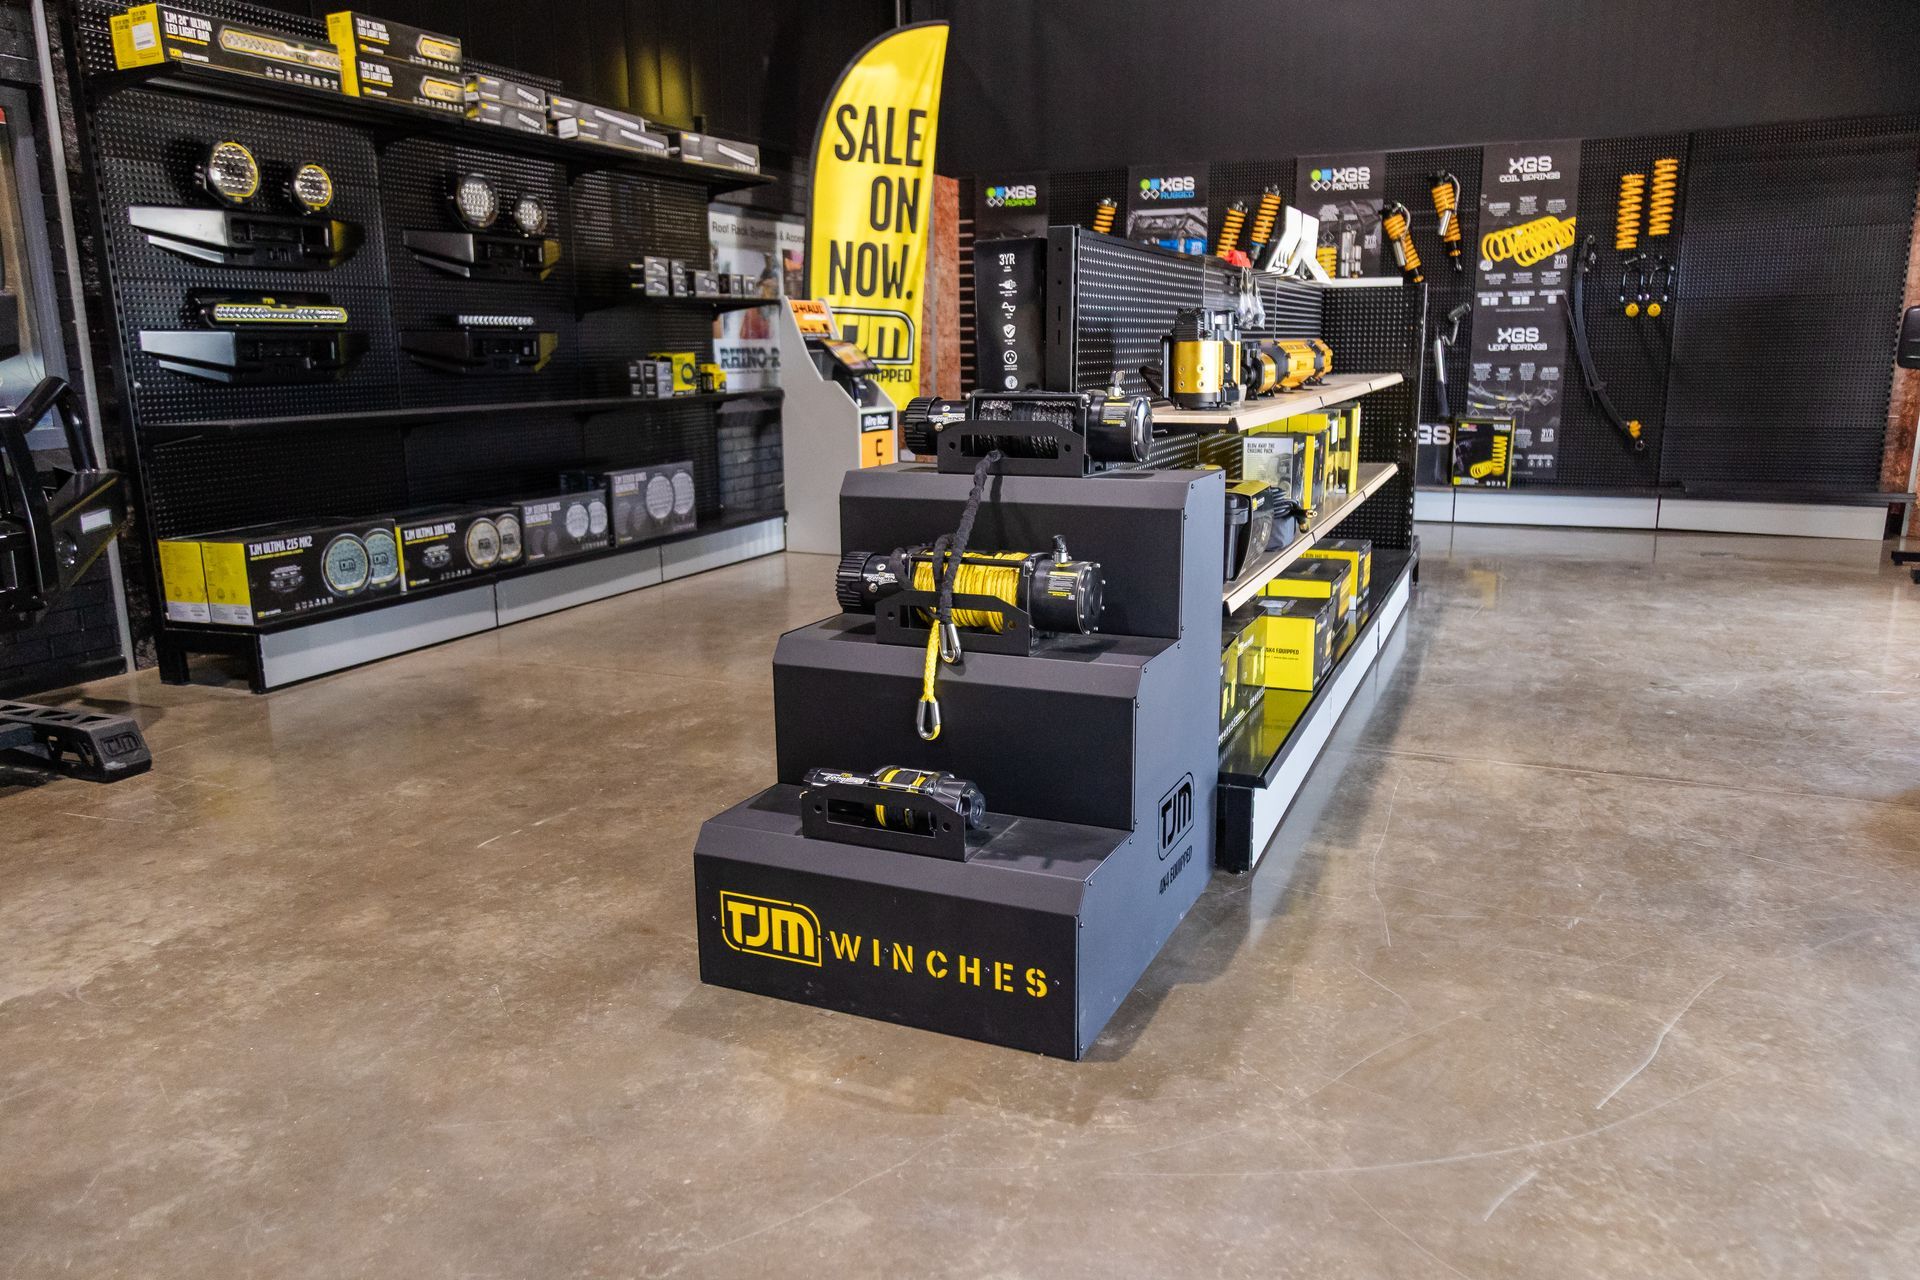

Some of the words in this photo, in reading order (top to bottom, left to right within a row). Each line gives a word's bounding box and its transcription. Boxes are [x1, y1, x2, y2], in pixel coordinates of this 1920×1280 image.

[165, 23, 178, 35] LED
[179, 26, 197, 38] LIGHT
[190, 17, 212, 31] ULTIMA
[834, 103, 927, 167] SALE
[1509, 156, 1552, 173] XGS
[1333, 167, 1370, 182] XGS
[1499, 175, 1520, 183] COIL
[1522, 171, 1561, 182] SPRINGS
[1160, 176, 1195, 191] XGS
[1332, 181, 1370, 191] REMOTE
[1005, 185, 1037, 199] XGS
[1160, 191, 1195, 199] RUGGED
[870, 175, 920, 234] ON
[712, 221, 729, 233] Roof
[998, 253, 1016, 265] 3YR
[829, 239, 914, 300] NOW.
[1497, 327, 1540, 343] XGS
[1488, 343, 1510, 351] LEAF
[249, 543, 262, 556] TJM
[262, 540, 286, 554] ULTIMA
[286, 537, 298, 550] 215
[298, 535, 313, 548] MK2
[1160, 778, 1193, 853] TJM
[724, 897, 818, 960] TJM
[829, 930, 1049, 998] WINCHES
